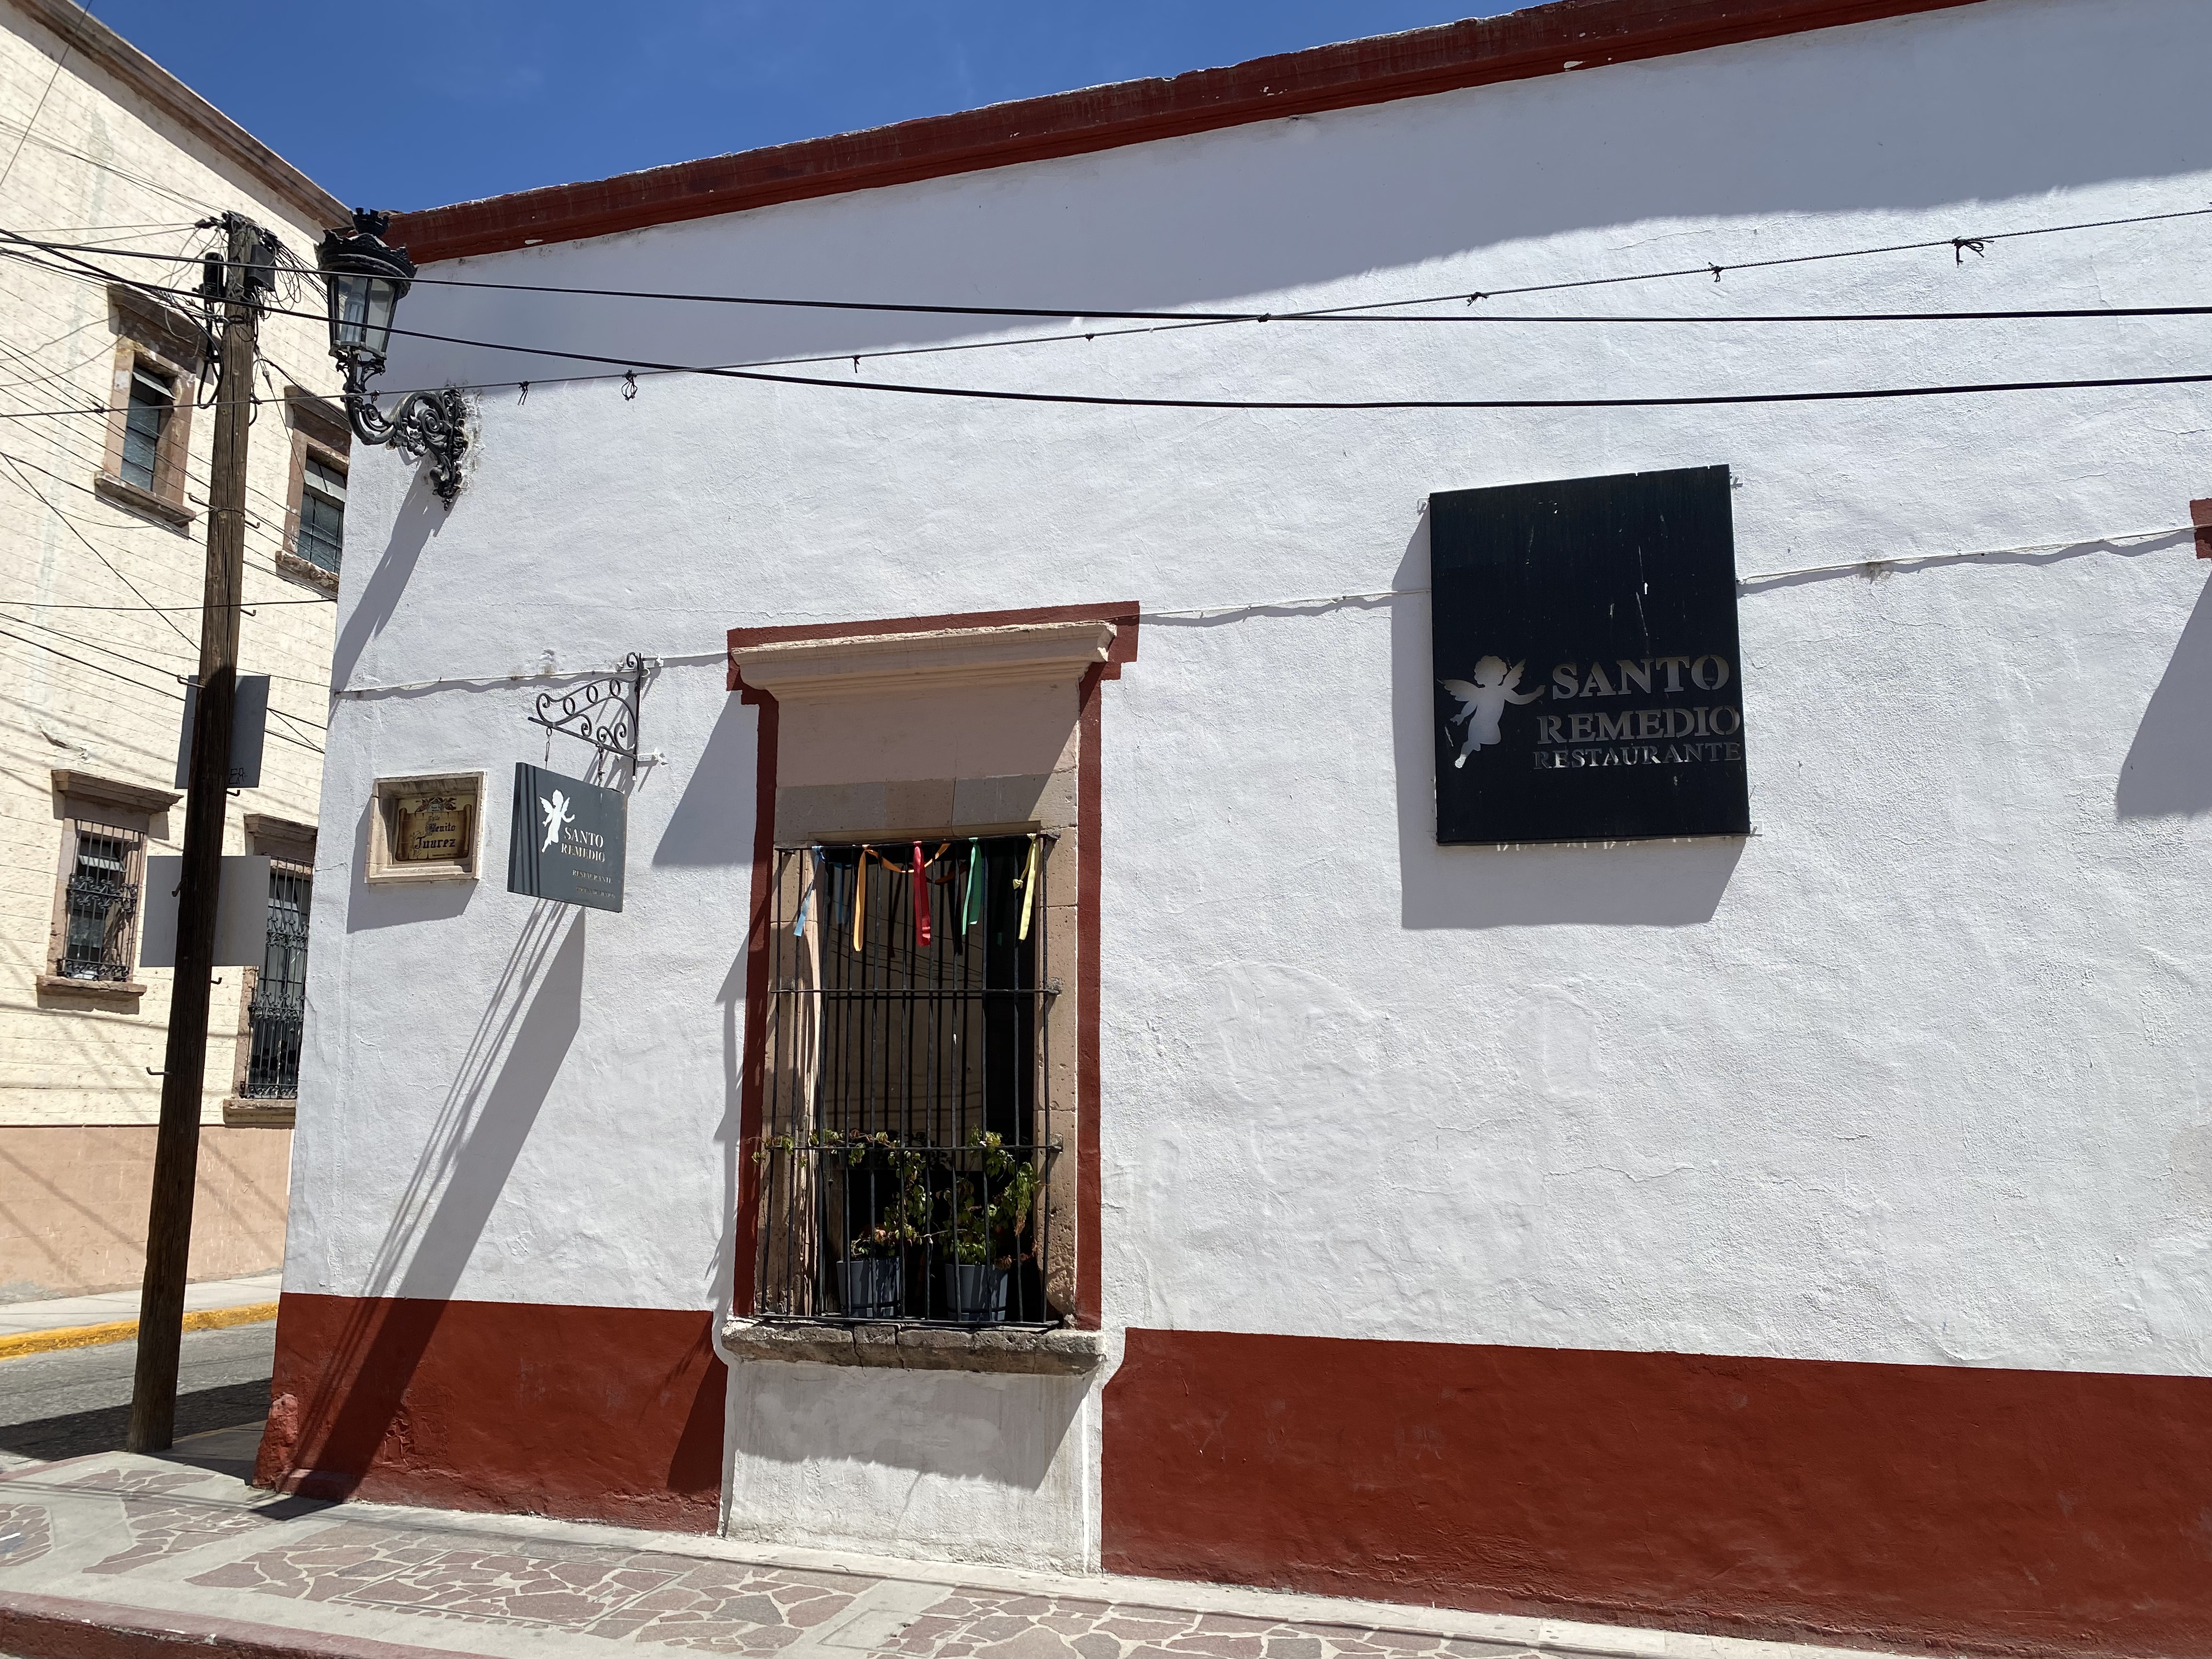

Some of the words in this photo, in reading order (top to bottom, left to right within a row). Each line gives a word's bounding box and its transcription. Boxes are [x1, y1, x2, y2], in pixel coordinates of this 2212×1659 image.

[1552, 654, 1730, 700] SANTO
[1537, 705, 1741, 744] REMEDIO
[1533, 742, 1741, 769] RESTAURANTE
[428, 822, 456, 832] Benito
[564, 826, 603, 848] SANTO
[561, 843, 605, 862] REMEDIO
